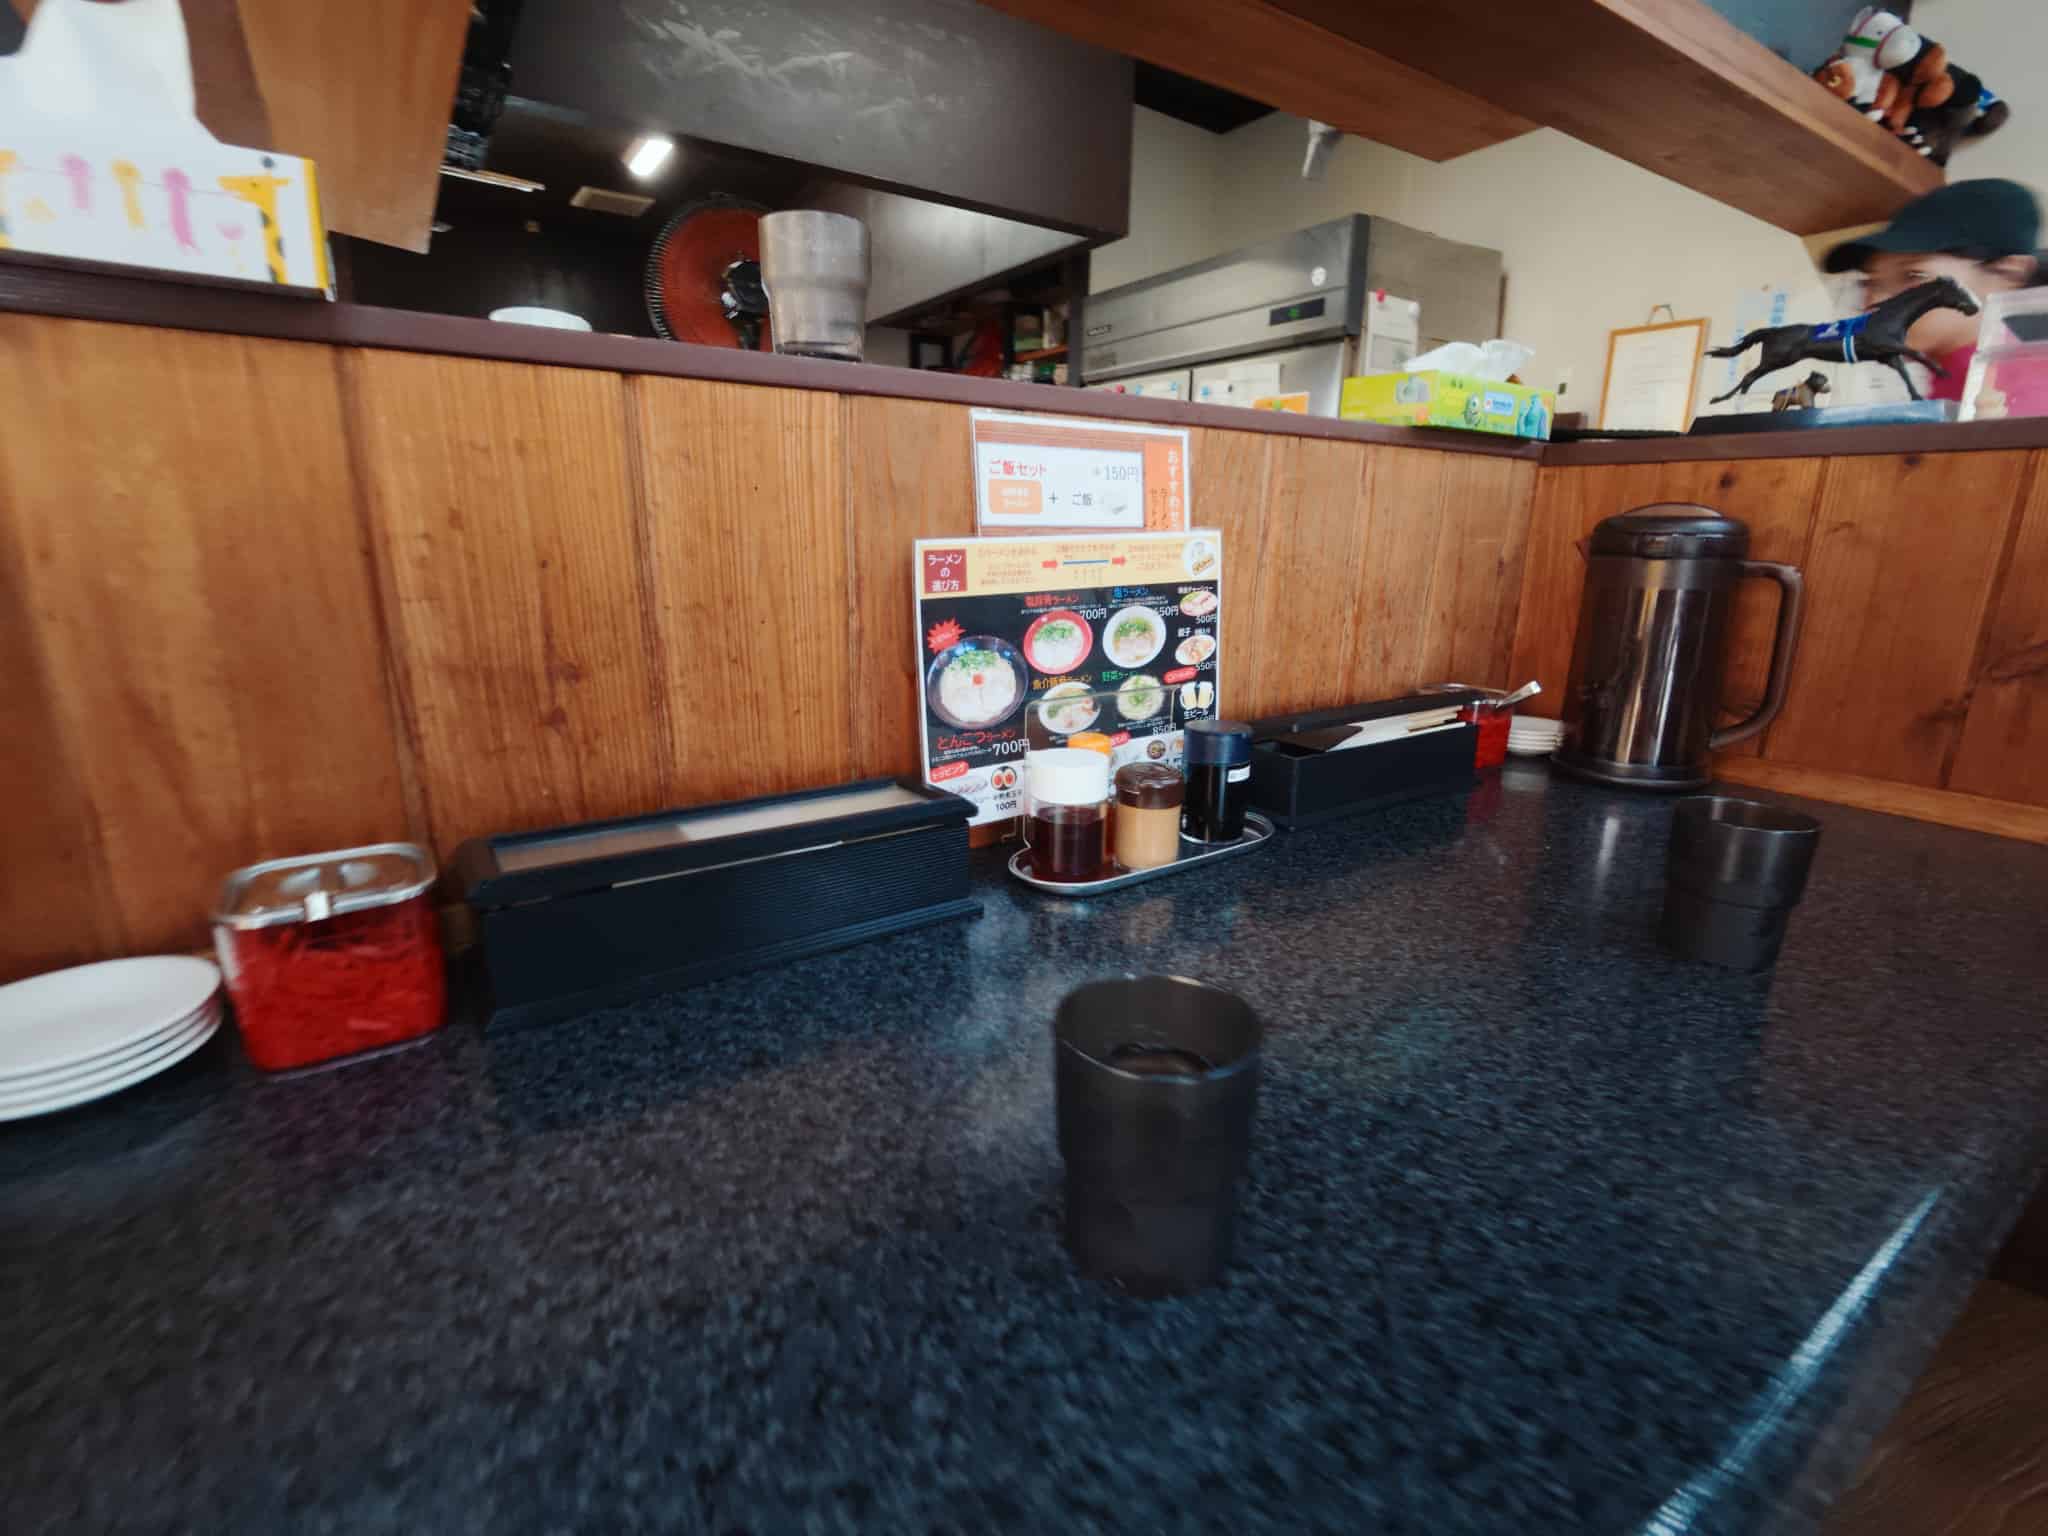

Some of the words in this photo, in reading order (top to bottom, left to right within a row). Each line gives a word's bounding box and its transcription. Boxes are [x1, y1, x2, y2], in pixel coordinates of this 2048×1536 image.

[990, 459, 1047, 477] ご飯セット
[927, 553, 963, 566] ラーメン
[940, 567, 951, 578] の
[1080, 607, 1107, 620] 700円
[992, 737, 1031, 757] 700円
